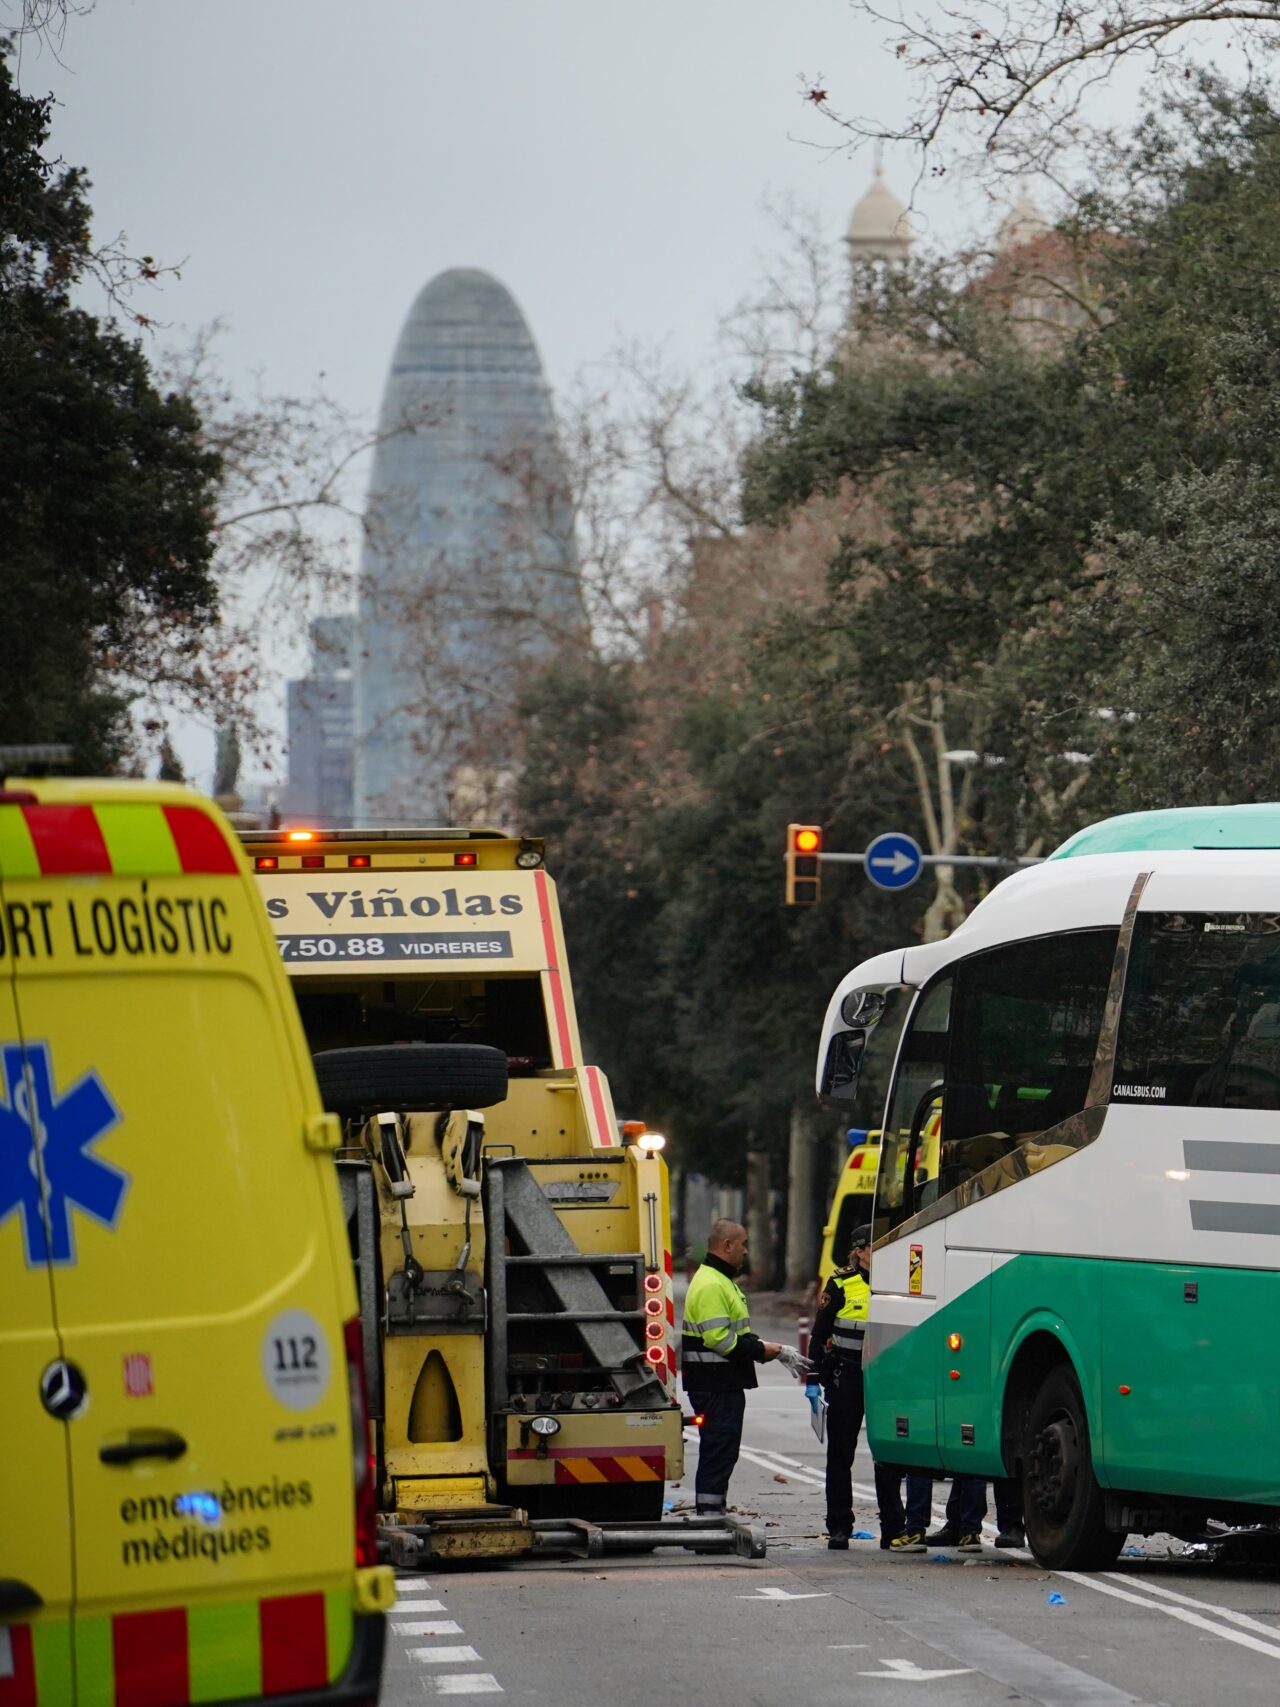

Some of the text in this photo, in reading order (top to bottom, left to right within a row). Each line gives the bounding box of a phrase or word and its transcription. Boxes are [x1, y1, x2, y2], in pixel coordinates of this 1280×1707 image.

[68, 880, 232, 955] LOGÍSTIC
[306, 888, 524, 919] Viñolas
[400, 941, 502, 955] VIDRERES
[1113, 1084, 1166, 1098] CANALSBUS.COM
[274, 1336, 318, 1371] 112
[121, 1476, 312, 1523] emeències
[121, 1526, 271, 1567] mèdiques
